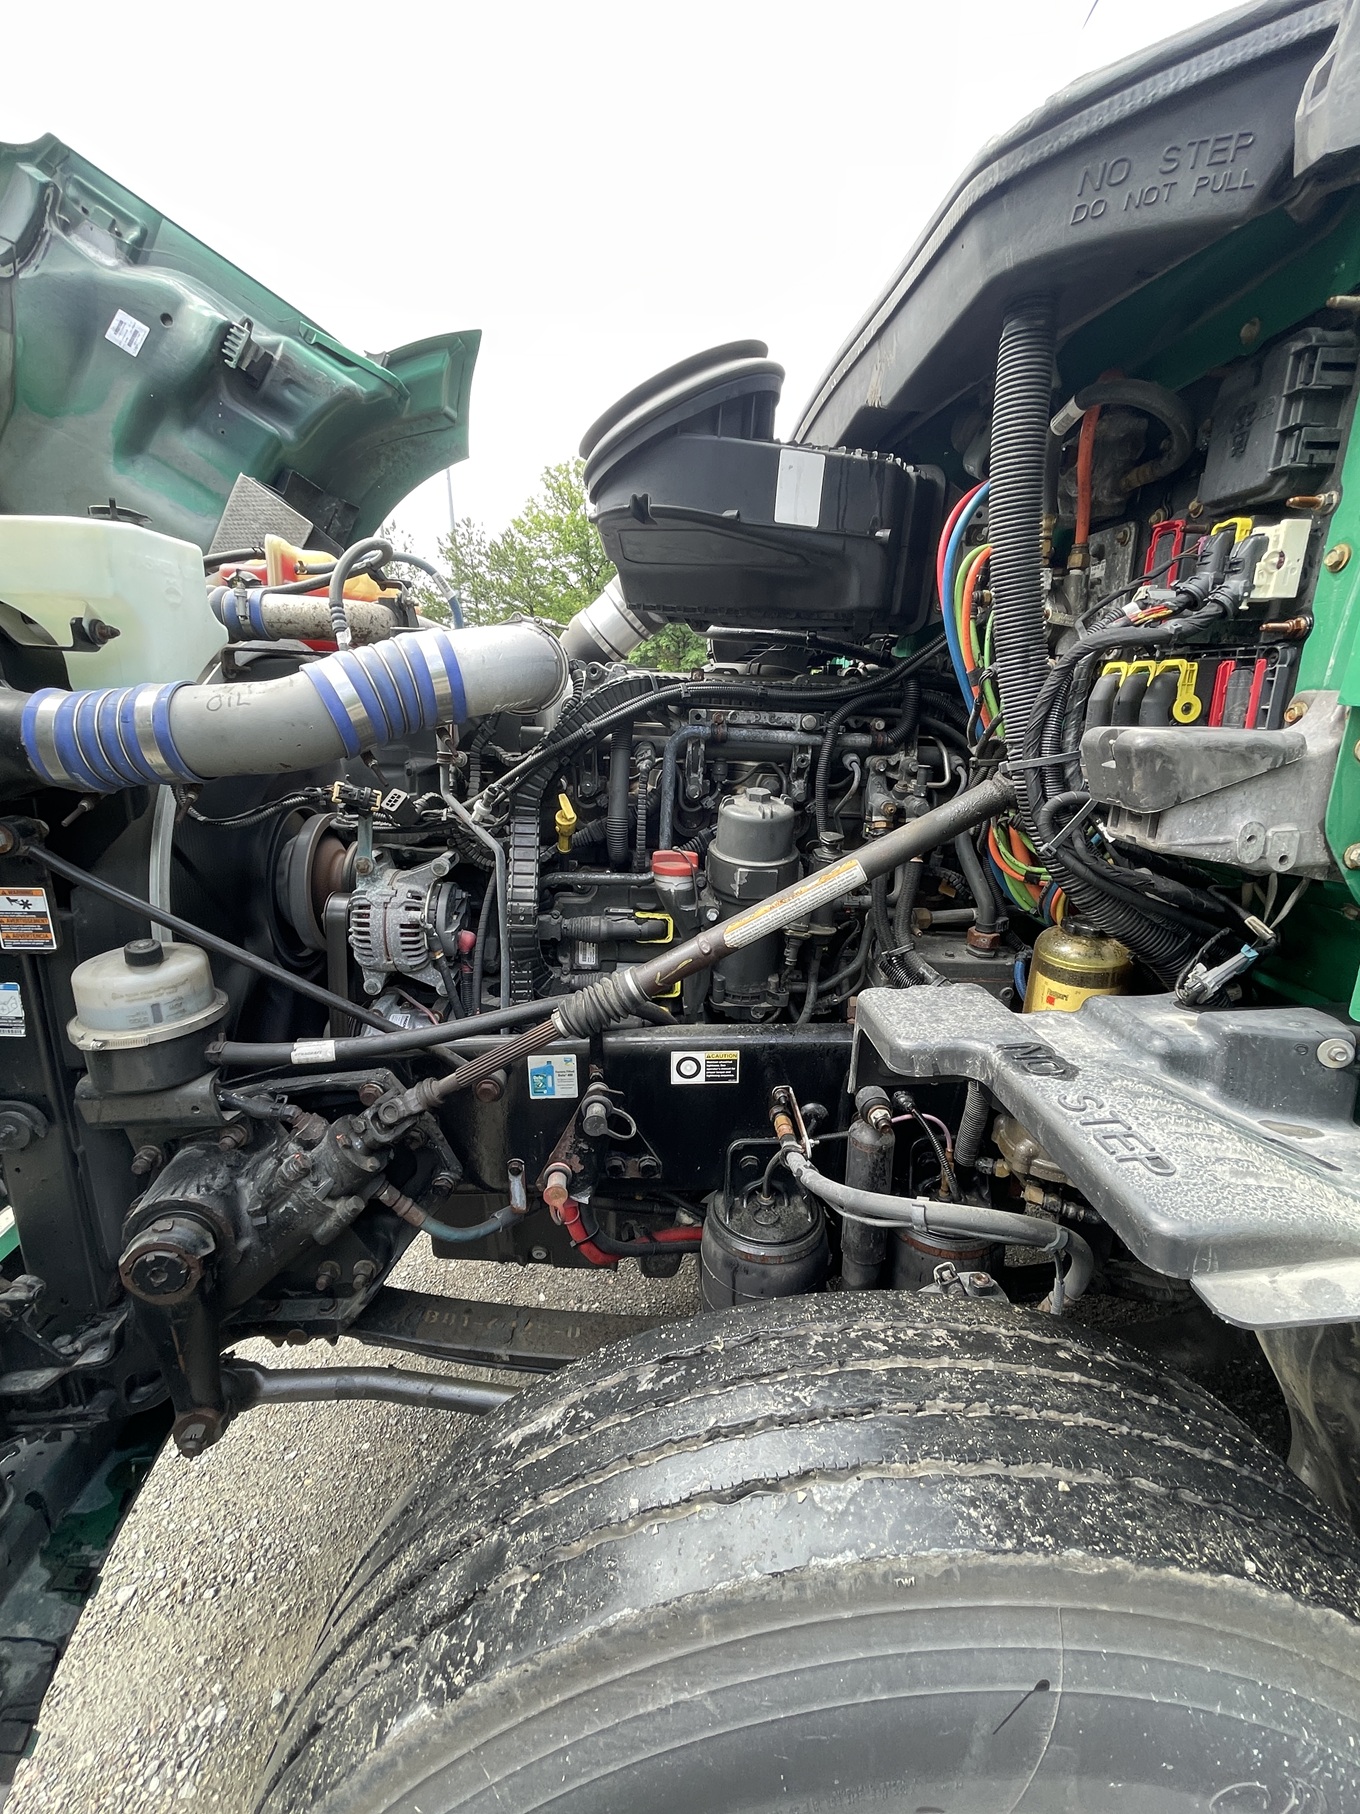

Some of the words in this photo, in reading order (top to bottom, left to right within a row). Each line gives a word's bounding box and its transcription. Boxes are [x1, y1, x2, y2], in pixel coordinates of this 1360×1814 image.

[1077, 157, 1131, 197] NO
[1158, 131, 1255, 174] STEP
[1069, 198, 1107, 226] DO
[1122, 181, 1178, 212] NOT
[1192, 167, 1256, 198] PULL
[206, 692, 251, 712] OIL
[996, 1041, 1066, 1077] NO
[1057, 1093, 1177, 1177] STEP
